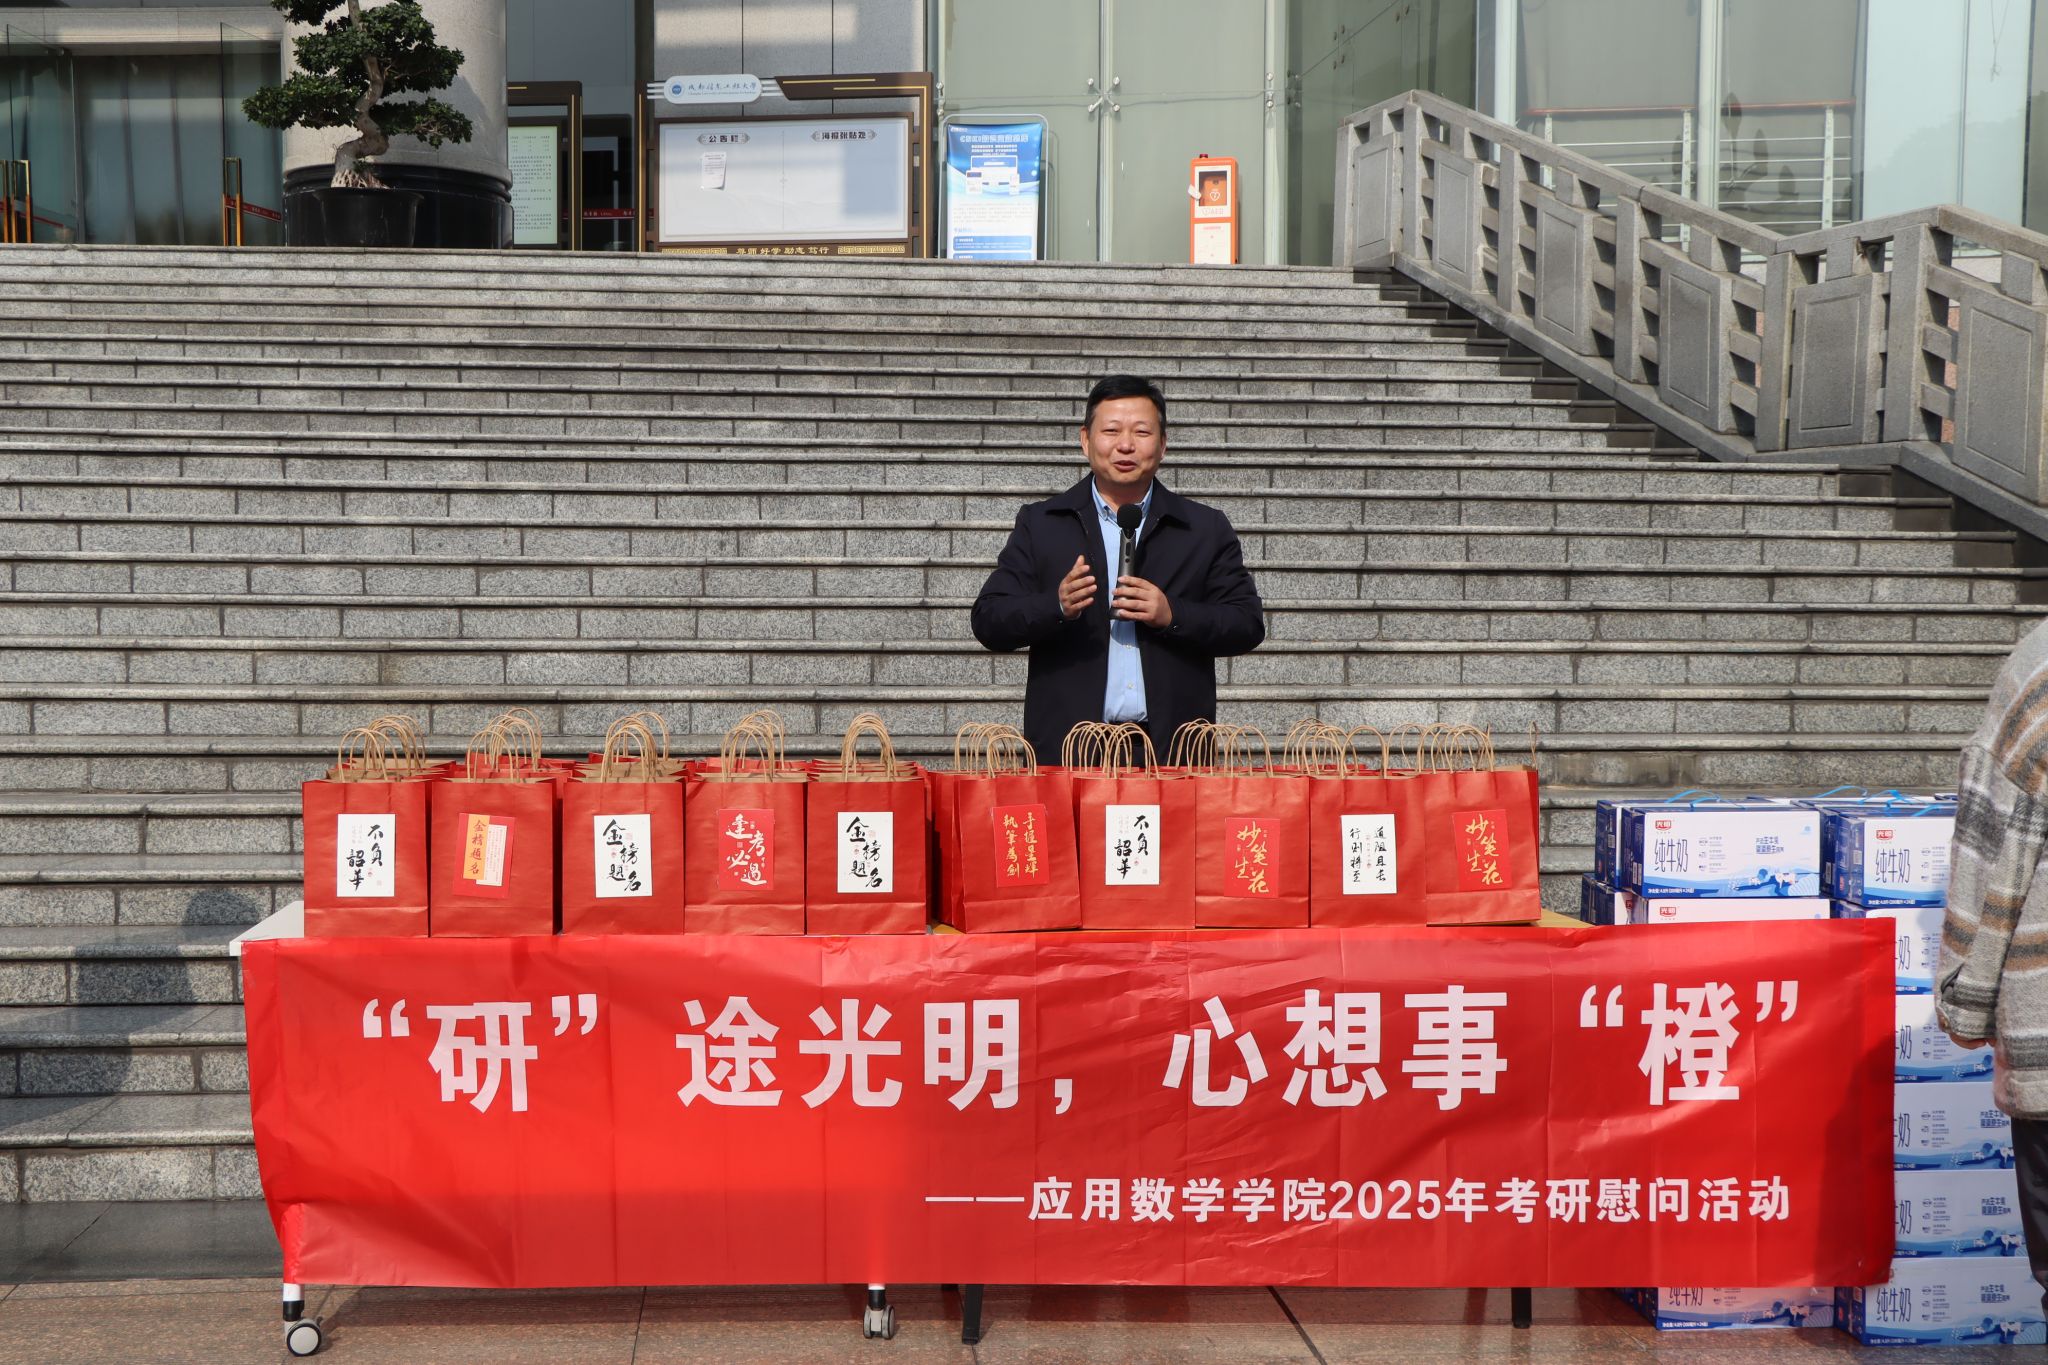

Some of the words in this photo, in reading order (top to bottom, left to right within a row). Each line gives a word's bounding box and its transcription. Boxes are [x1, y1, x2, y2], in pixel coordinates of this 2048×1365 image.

[708, 135, 739, 143] 公告栏
[1654, 837, 1689, 873] 纯牛奶
[1875, 848, 1911, 884] 纯牛奶
[1876, 1287, 1912, 1323] 纯牛奶
